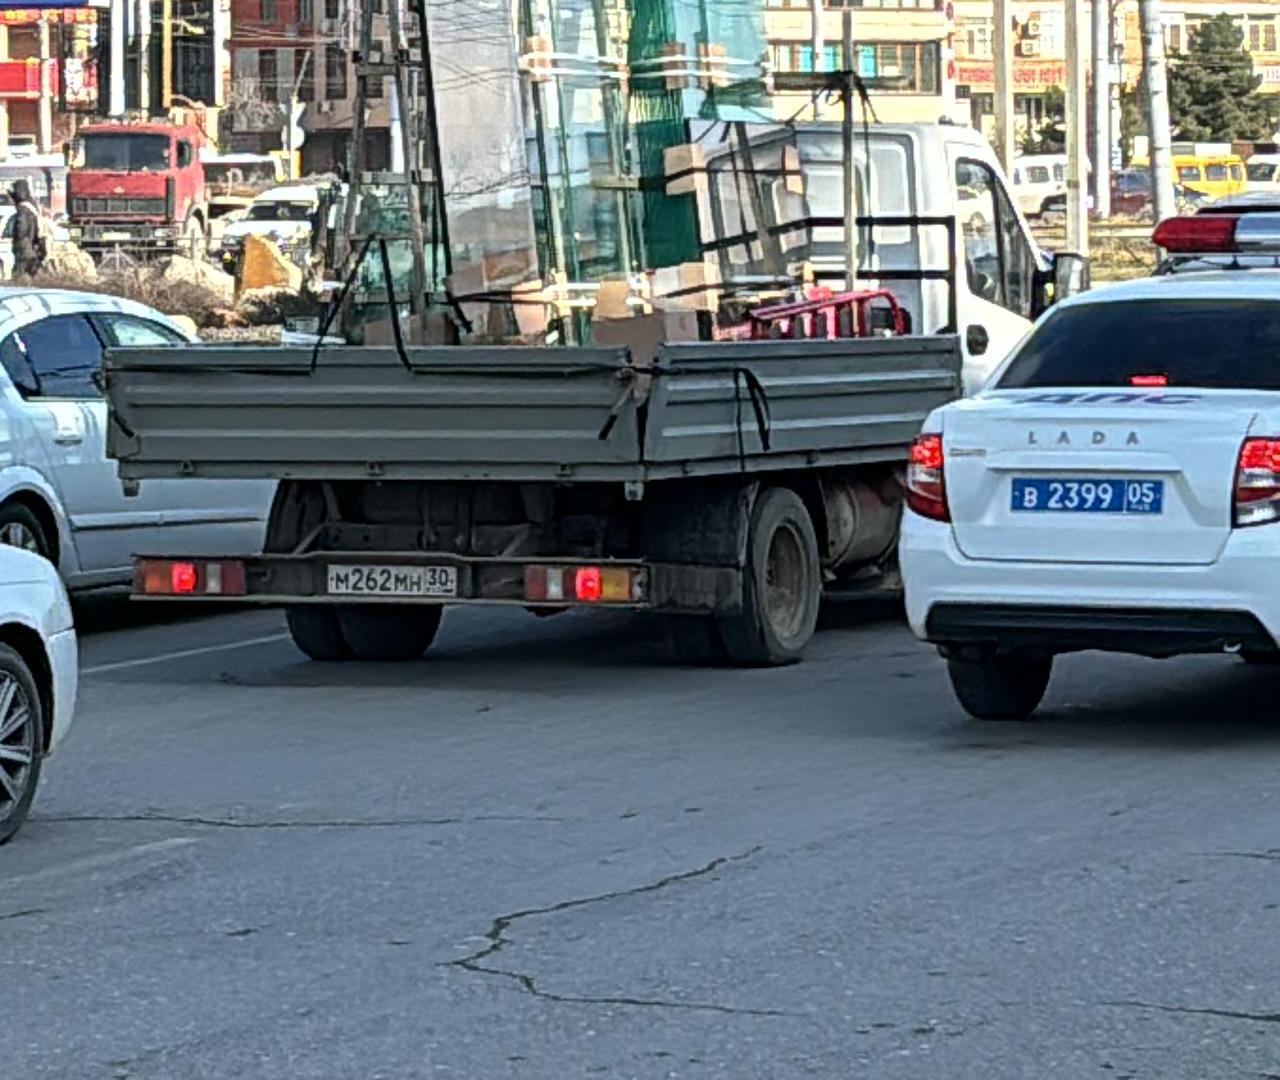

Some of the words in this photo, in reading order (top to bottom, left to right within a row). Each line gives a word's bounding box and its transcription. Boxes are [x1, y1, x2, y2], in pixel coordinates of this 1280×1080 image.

[1027, 430, 1140, 445] LADA
[1023, 486, 1038, 508] В
[1046, 482, 1114, 509] 2399
[1127, 482, 1155, 504] 05
[427, 567, 450, 587] 30
